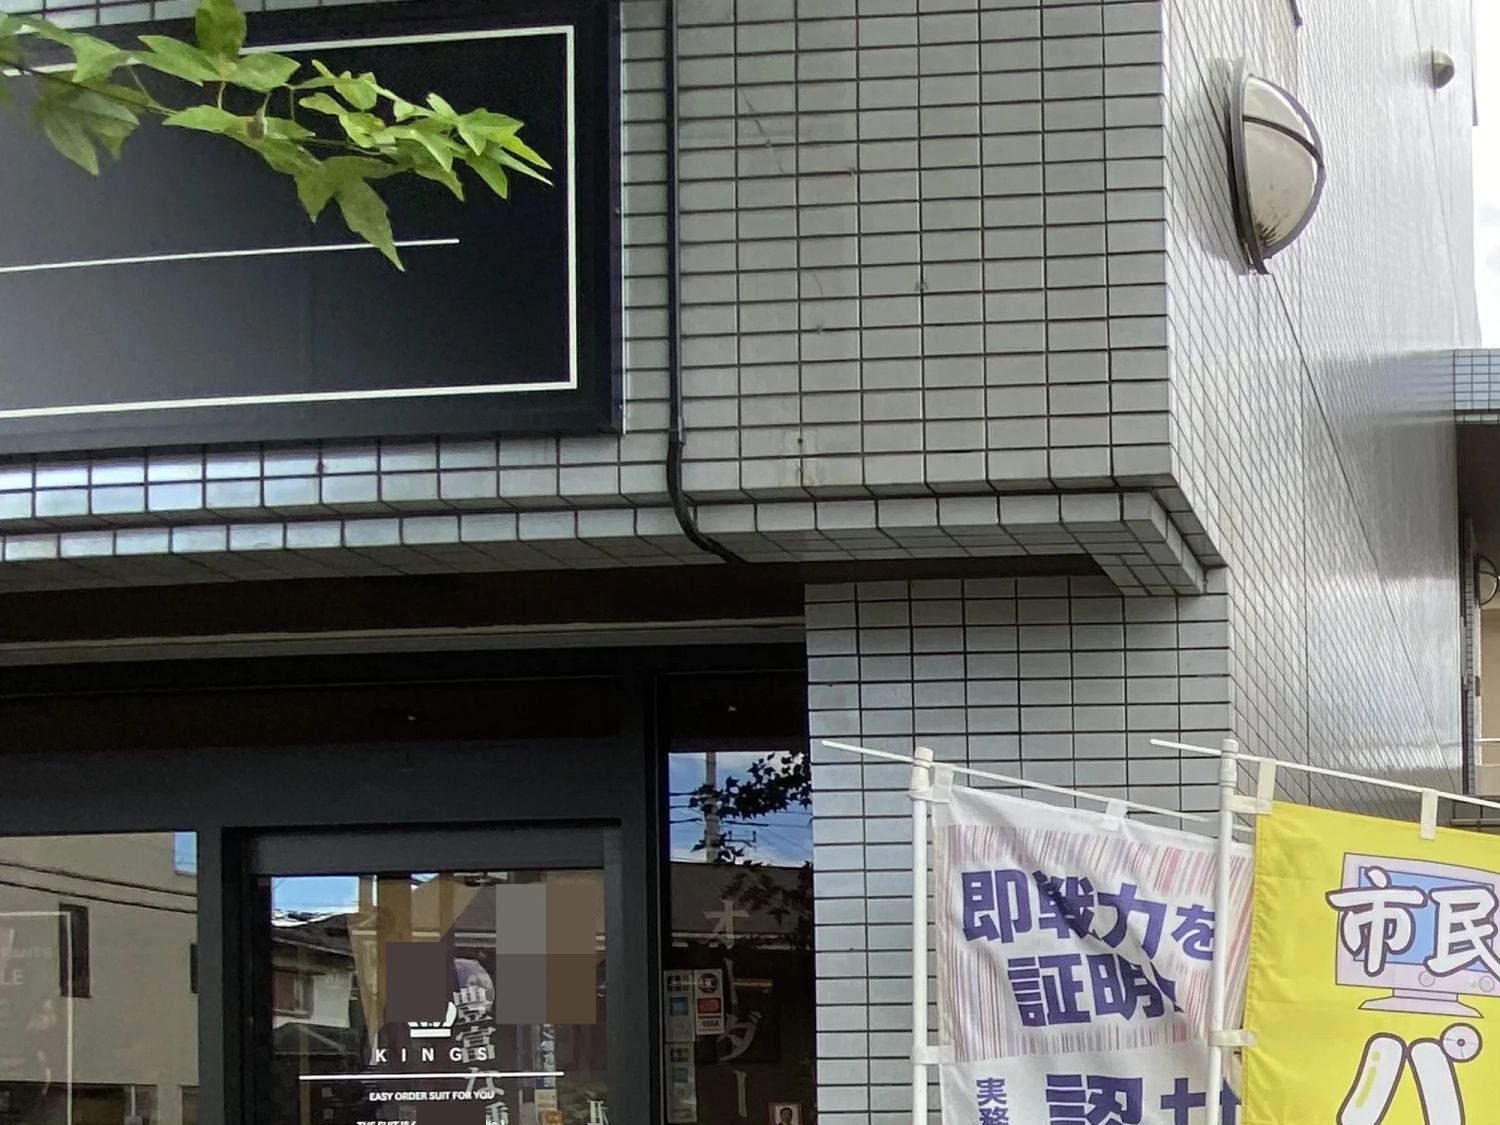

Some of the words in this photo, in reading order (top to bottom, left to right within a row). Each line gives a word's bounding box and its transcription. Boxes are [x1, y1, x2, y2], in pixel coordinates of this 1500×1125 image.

[962, 869, 1216, 961] 即戦力を
[375, 1047, 488, 1063] KINGS
[369, 1091, 394, 1101] EASY
[394, 1091, 427, 1101] ORDER
[429, 1090, 451, 1100] SUIT
[452, 1090, 472, 1100] FOR
[473, 1090, 496, 1100] YOU
